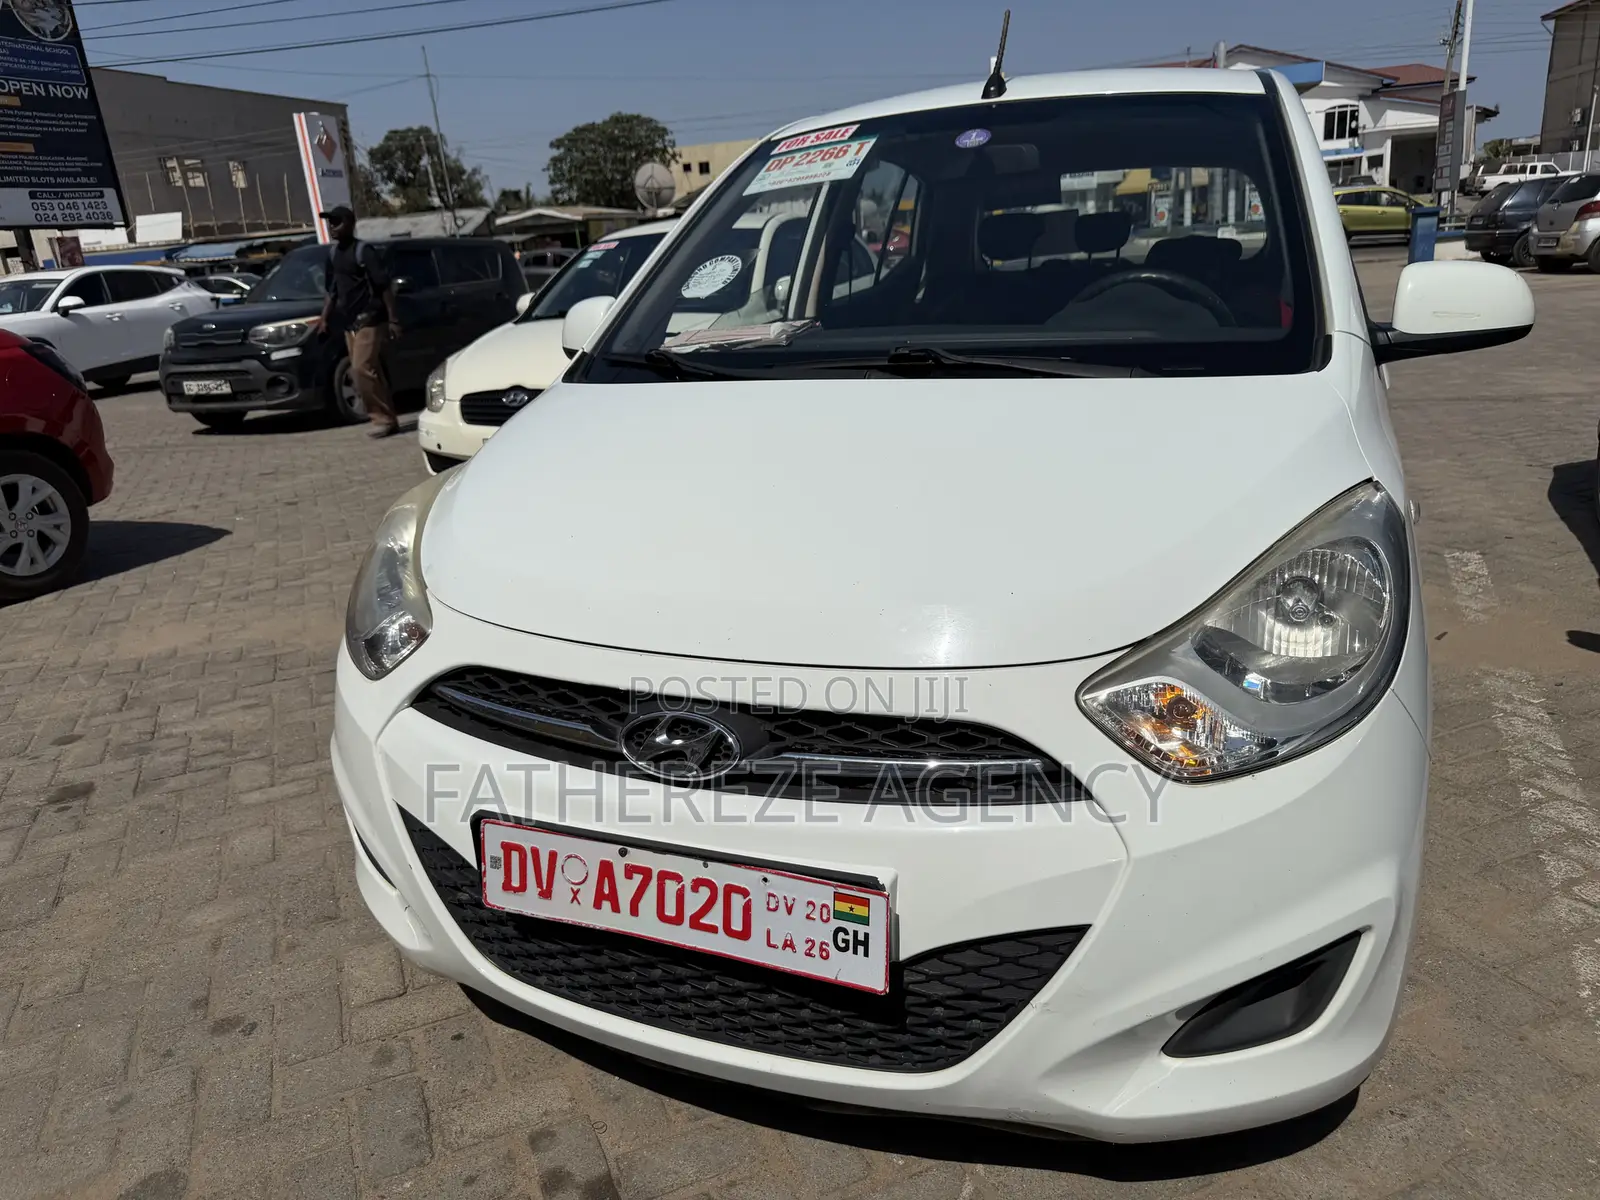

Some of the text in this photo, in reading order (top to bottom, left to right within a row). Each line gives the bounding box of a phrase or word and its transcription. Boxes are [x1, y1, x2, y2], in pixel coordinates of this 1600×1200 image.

[48, 84, 89, 99] NOW
[777, 127, 853, 151] FOR SALE
[763, 140, 871, 173] DP 2266 T
[30, 176, 56, 184] SLOTS
[31, 200, 108, 211] 053 046 1423
[34, 213, 59, 222] 024
[500, 841, 752, 941] DV A7020
[766, 892, 831, 924] DV 20
[766, 927, 831, 960] LA 26
[832, 925, 870, 959] GH
